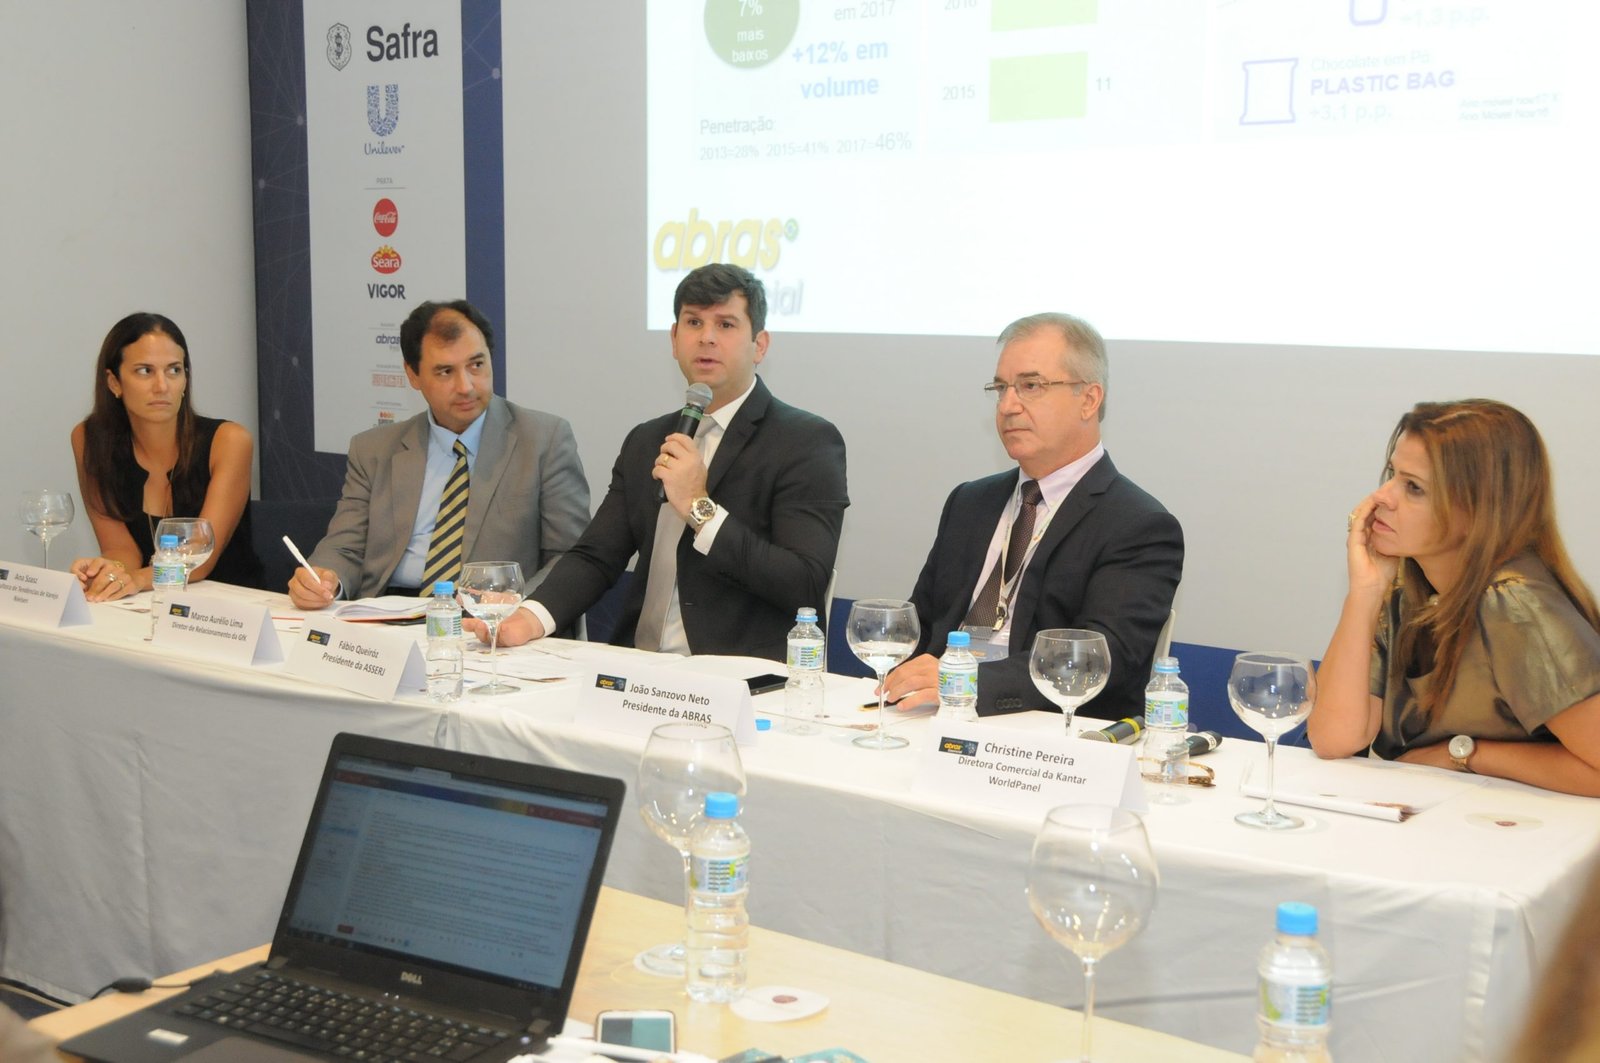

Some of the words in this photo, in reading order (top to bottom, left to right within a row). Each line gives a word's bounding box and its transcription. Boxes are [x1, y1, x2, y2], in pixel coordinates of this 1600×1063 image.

[738, 0, 763, 17] 7%
[834, 7, 857, 21] em
[859, 0, 896, 19] 2017
[366, 22, 439, 62] Safra
[736, 28, 764, 42] mais
[732, 48, 769, 63] baixos
[792, 41, 849, 65] +12%
[855, 41, 889, 61] em
[800, 76, 880, 99] volume
[1096, 76, 1112, 92] 11
[1310, 74, 1400, 96] PLASTIC
[1406, 70, 1456, 91] BAG
[942, 85, 976, 101] 2015
[364, 141, 403, 155] Unilever
[653, 207, 783, 273] abras
[372, 256, 400, 269] Seara
[367, 283, 406, 300] VIGOR
[171, 621, 188, 631] Diretor
[190, 611, 209, 623] Marco
[209, 614, 229, 626] Aurélio
[229, 617, 244, 629] Lima
[338, 640, 355, 652] Fábio
[322, 652, 355, 668] Presidente
[354, 660, 363, 671] da
[363, 663, 386, 677] ASSERJ
[629, 683, 650, 696] João
[650, 686, 687, 702] Sanzovo
[688, 693, 710, 706] Neto
[622, 699, 667, 716] Presidente
[668, 707, 680, 718] da
[681, 710, 712, 724] ABRAS
[984, 742, 1033, 760] Christine
[1035, 750, 1075, 767] Pereira
[958, 756, 994, 770] Diretora
[995, 762, 1040, 778] Comercial
[1042, 769, 1054, 780] da
[1055, 772, 1087, 786] Kantar
[988, 775, 1042, 793] WorldPanel
